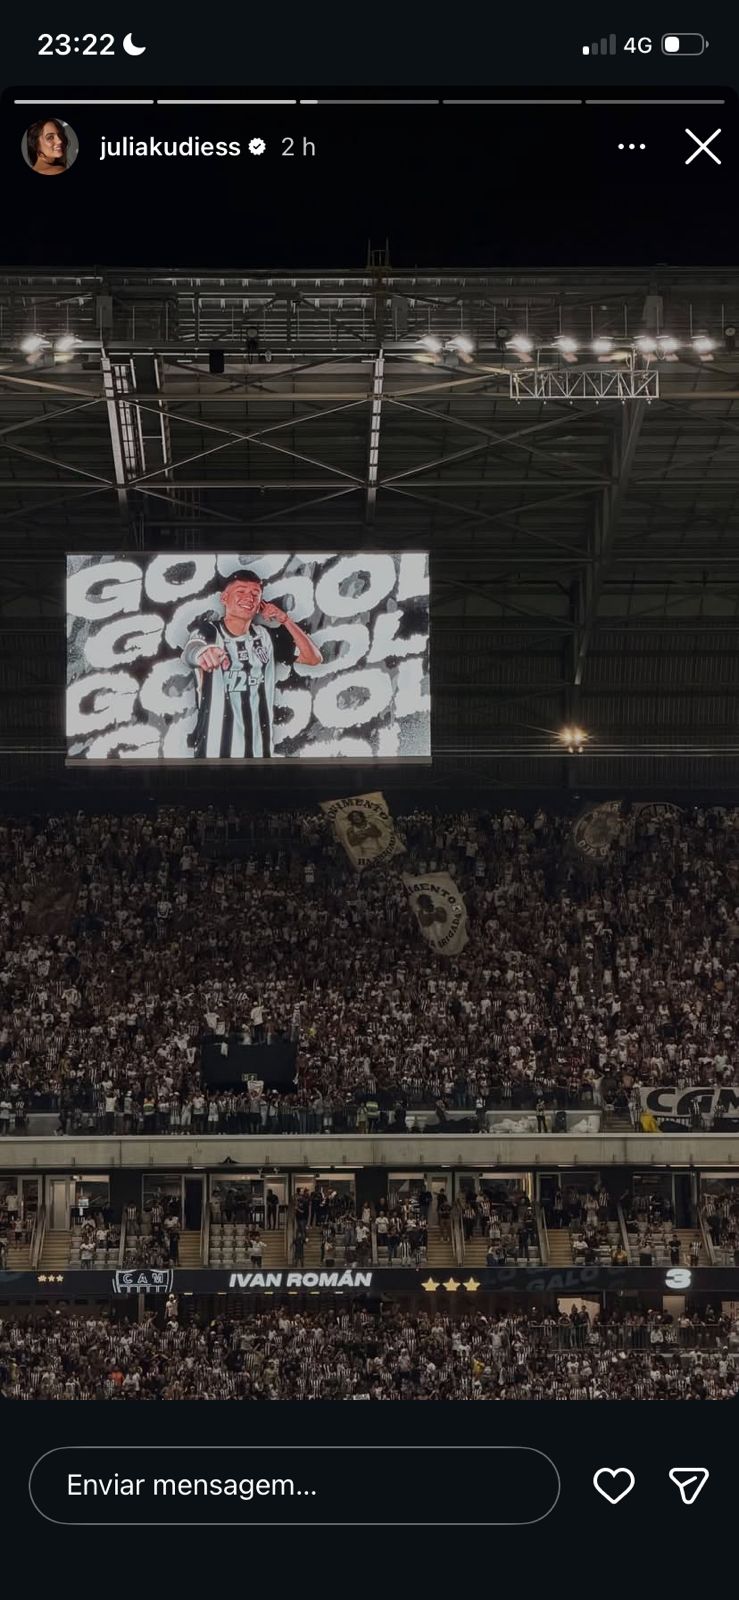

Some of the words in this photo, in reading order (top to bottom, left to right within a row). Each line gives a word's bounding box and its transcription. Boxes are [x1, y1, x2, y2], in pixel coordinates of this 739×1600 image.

[122, 1272, 165, 1285] CAM
[229, 1273, 283, 1288] IVAN
[286, 1270, 373, 1287] ROMÁN
[664, 1268, 692, 1289] 3
